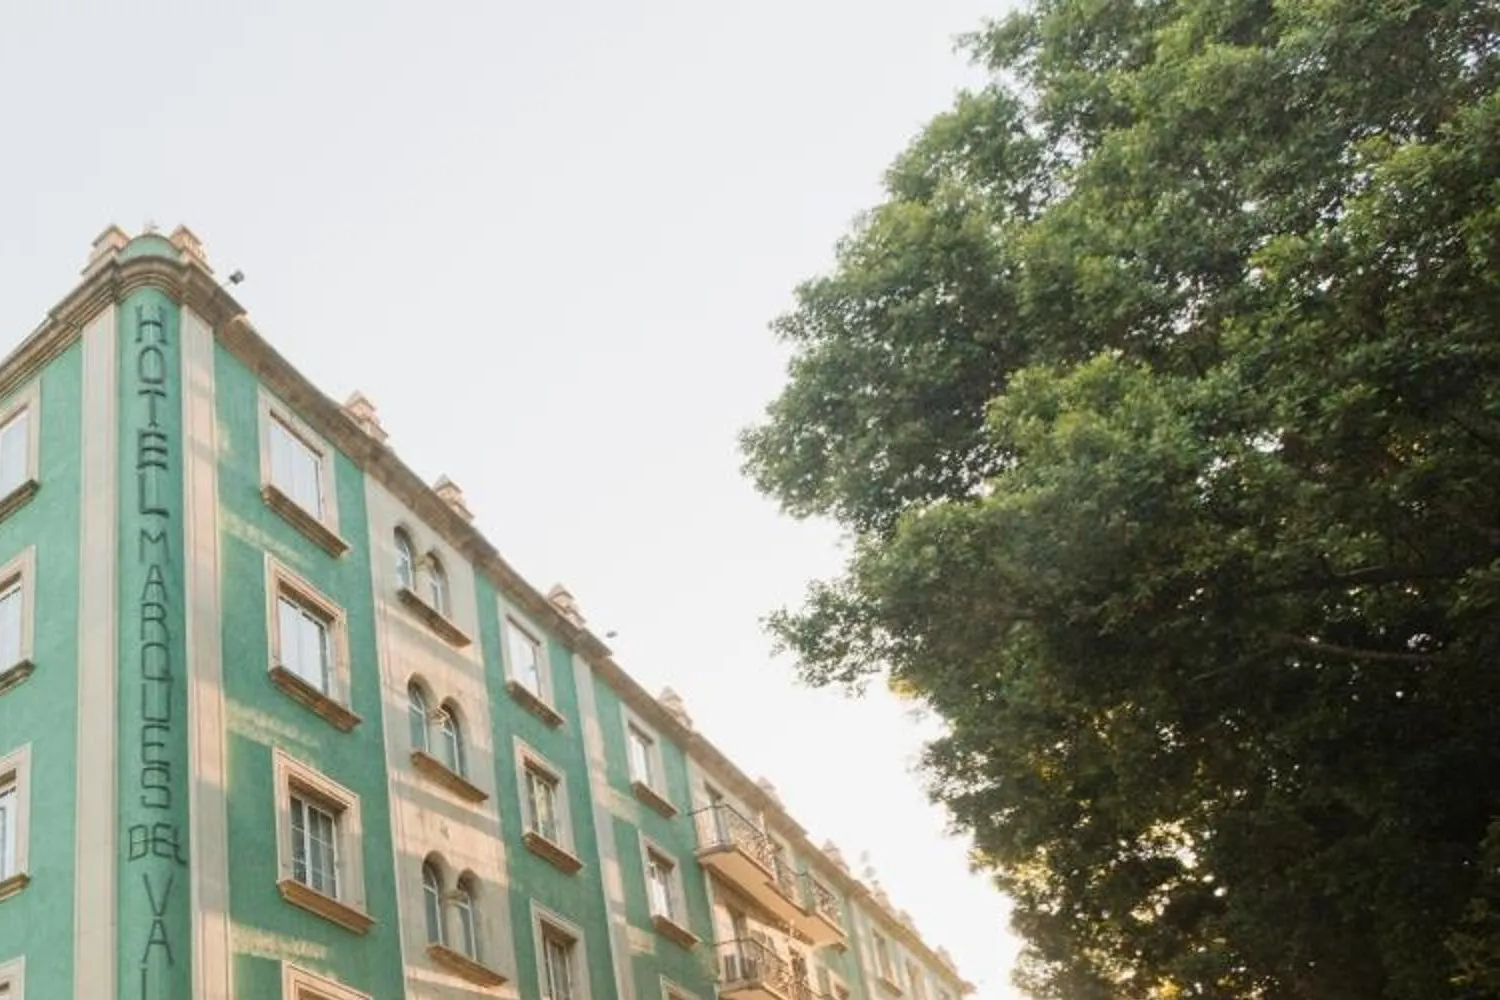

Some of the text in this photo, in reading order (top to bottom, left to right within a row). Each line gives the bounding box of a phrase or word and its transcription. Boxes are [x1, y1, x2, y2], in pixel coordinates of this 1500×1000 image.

[135, 304, 170, 518] HOTEL
[138, 528, 174, 810] MARQUES
[127, 822, 187, 867] DEL
